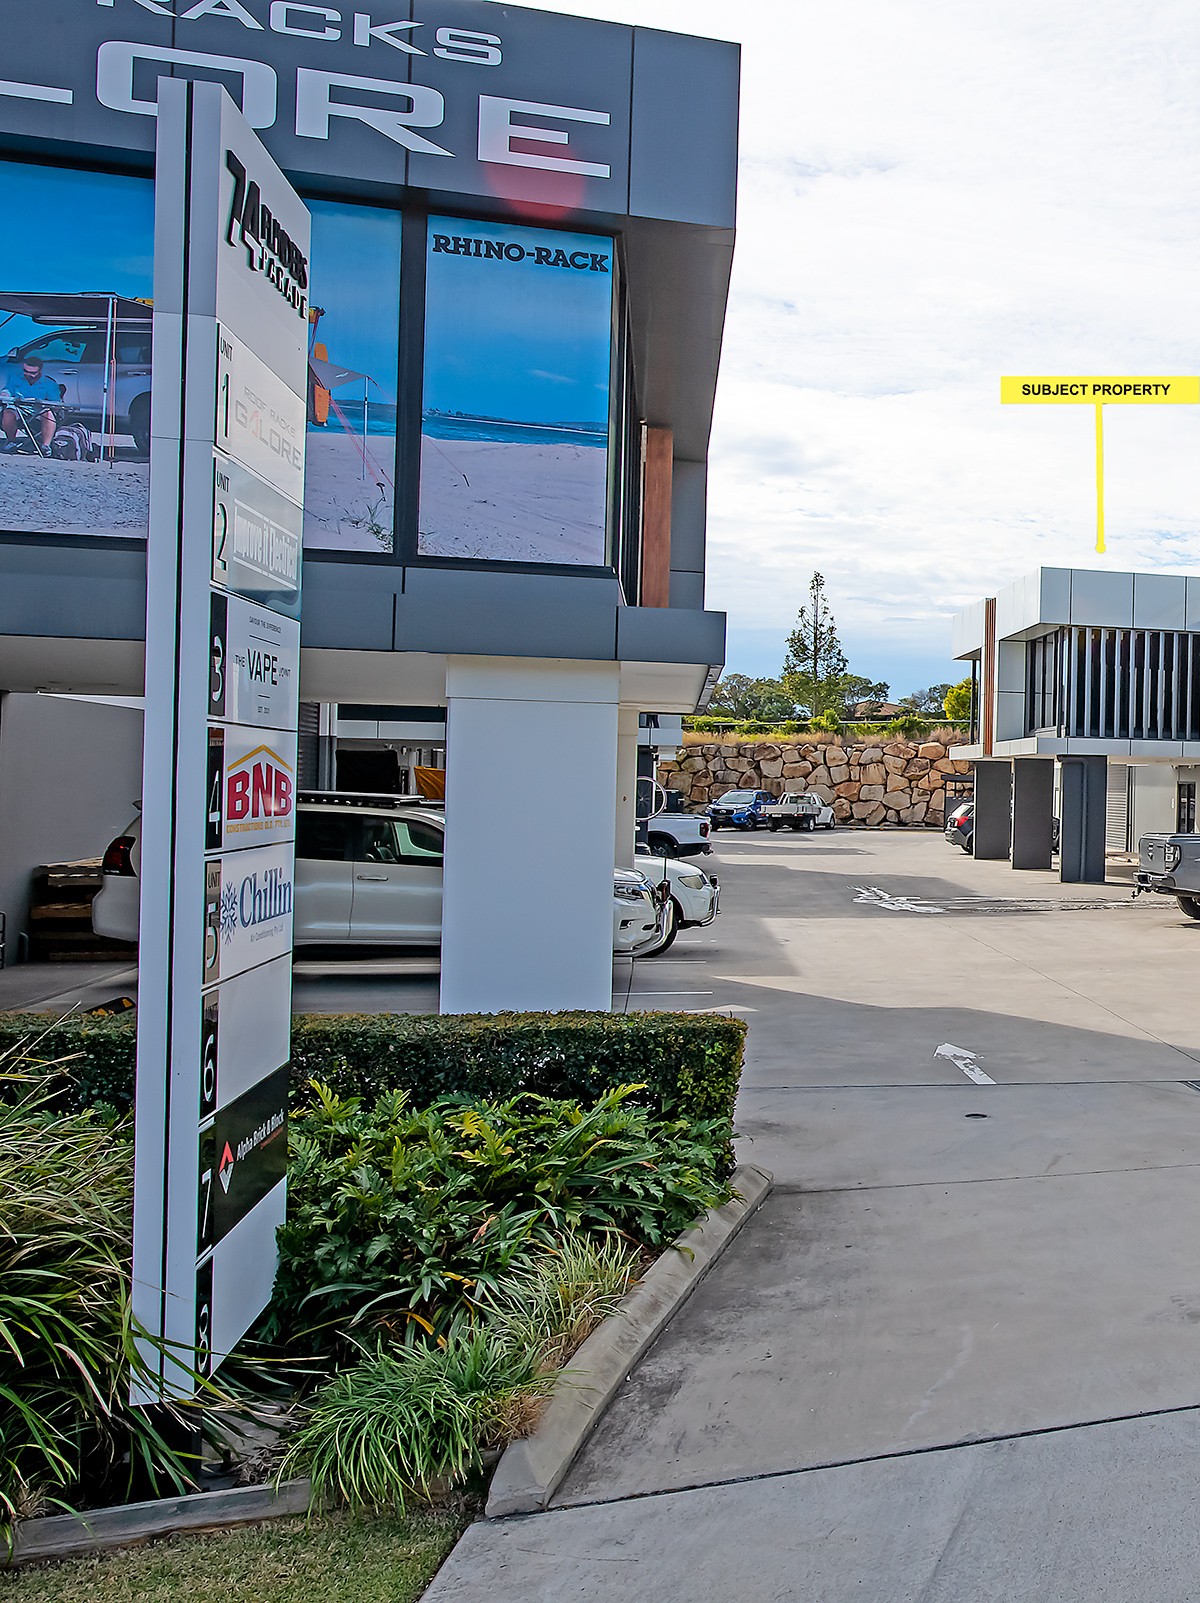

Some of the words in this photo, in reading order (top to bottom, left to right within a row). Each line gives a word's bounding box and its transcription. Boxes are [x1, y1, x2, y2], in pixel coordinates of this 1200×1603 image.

[260, 246, 308, 319] PARADE
[432, 234, 609, 273] RHINO-RACK
[220, 336, 233, 362] UNIT
[221, 373, 230, 439] 1
[216, 470, 229, 493] UNIT
[216, 502, 227, 571] 2
[212, 635, 223, 702] 3
[235, 654, 246, 668] THE
[247, 648, 278, 686] VAPE
[208, 770, 220, 835] 4
[227, 761, 292, 820] BNB
[239, 866, 292, 929] Chillin
[206, 901, 219, 968] 5
[203, 1033, 215, 1102] 6
[236, 1136, 253, 1161] Alpha
[253, 1123, 267, 1147] Brick
[271, 1108, 284, 1131] Block
[201, 1168, 212, 1239] 7
[198, 1303, 209, 1374] 8
